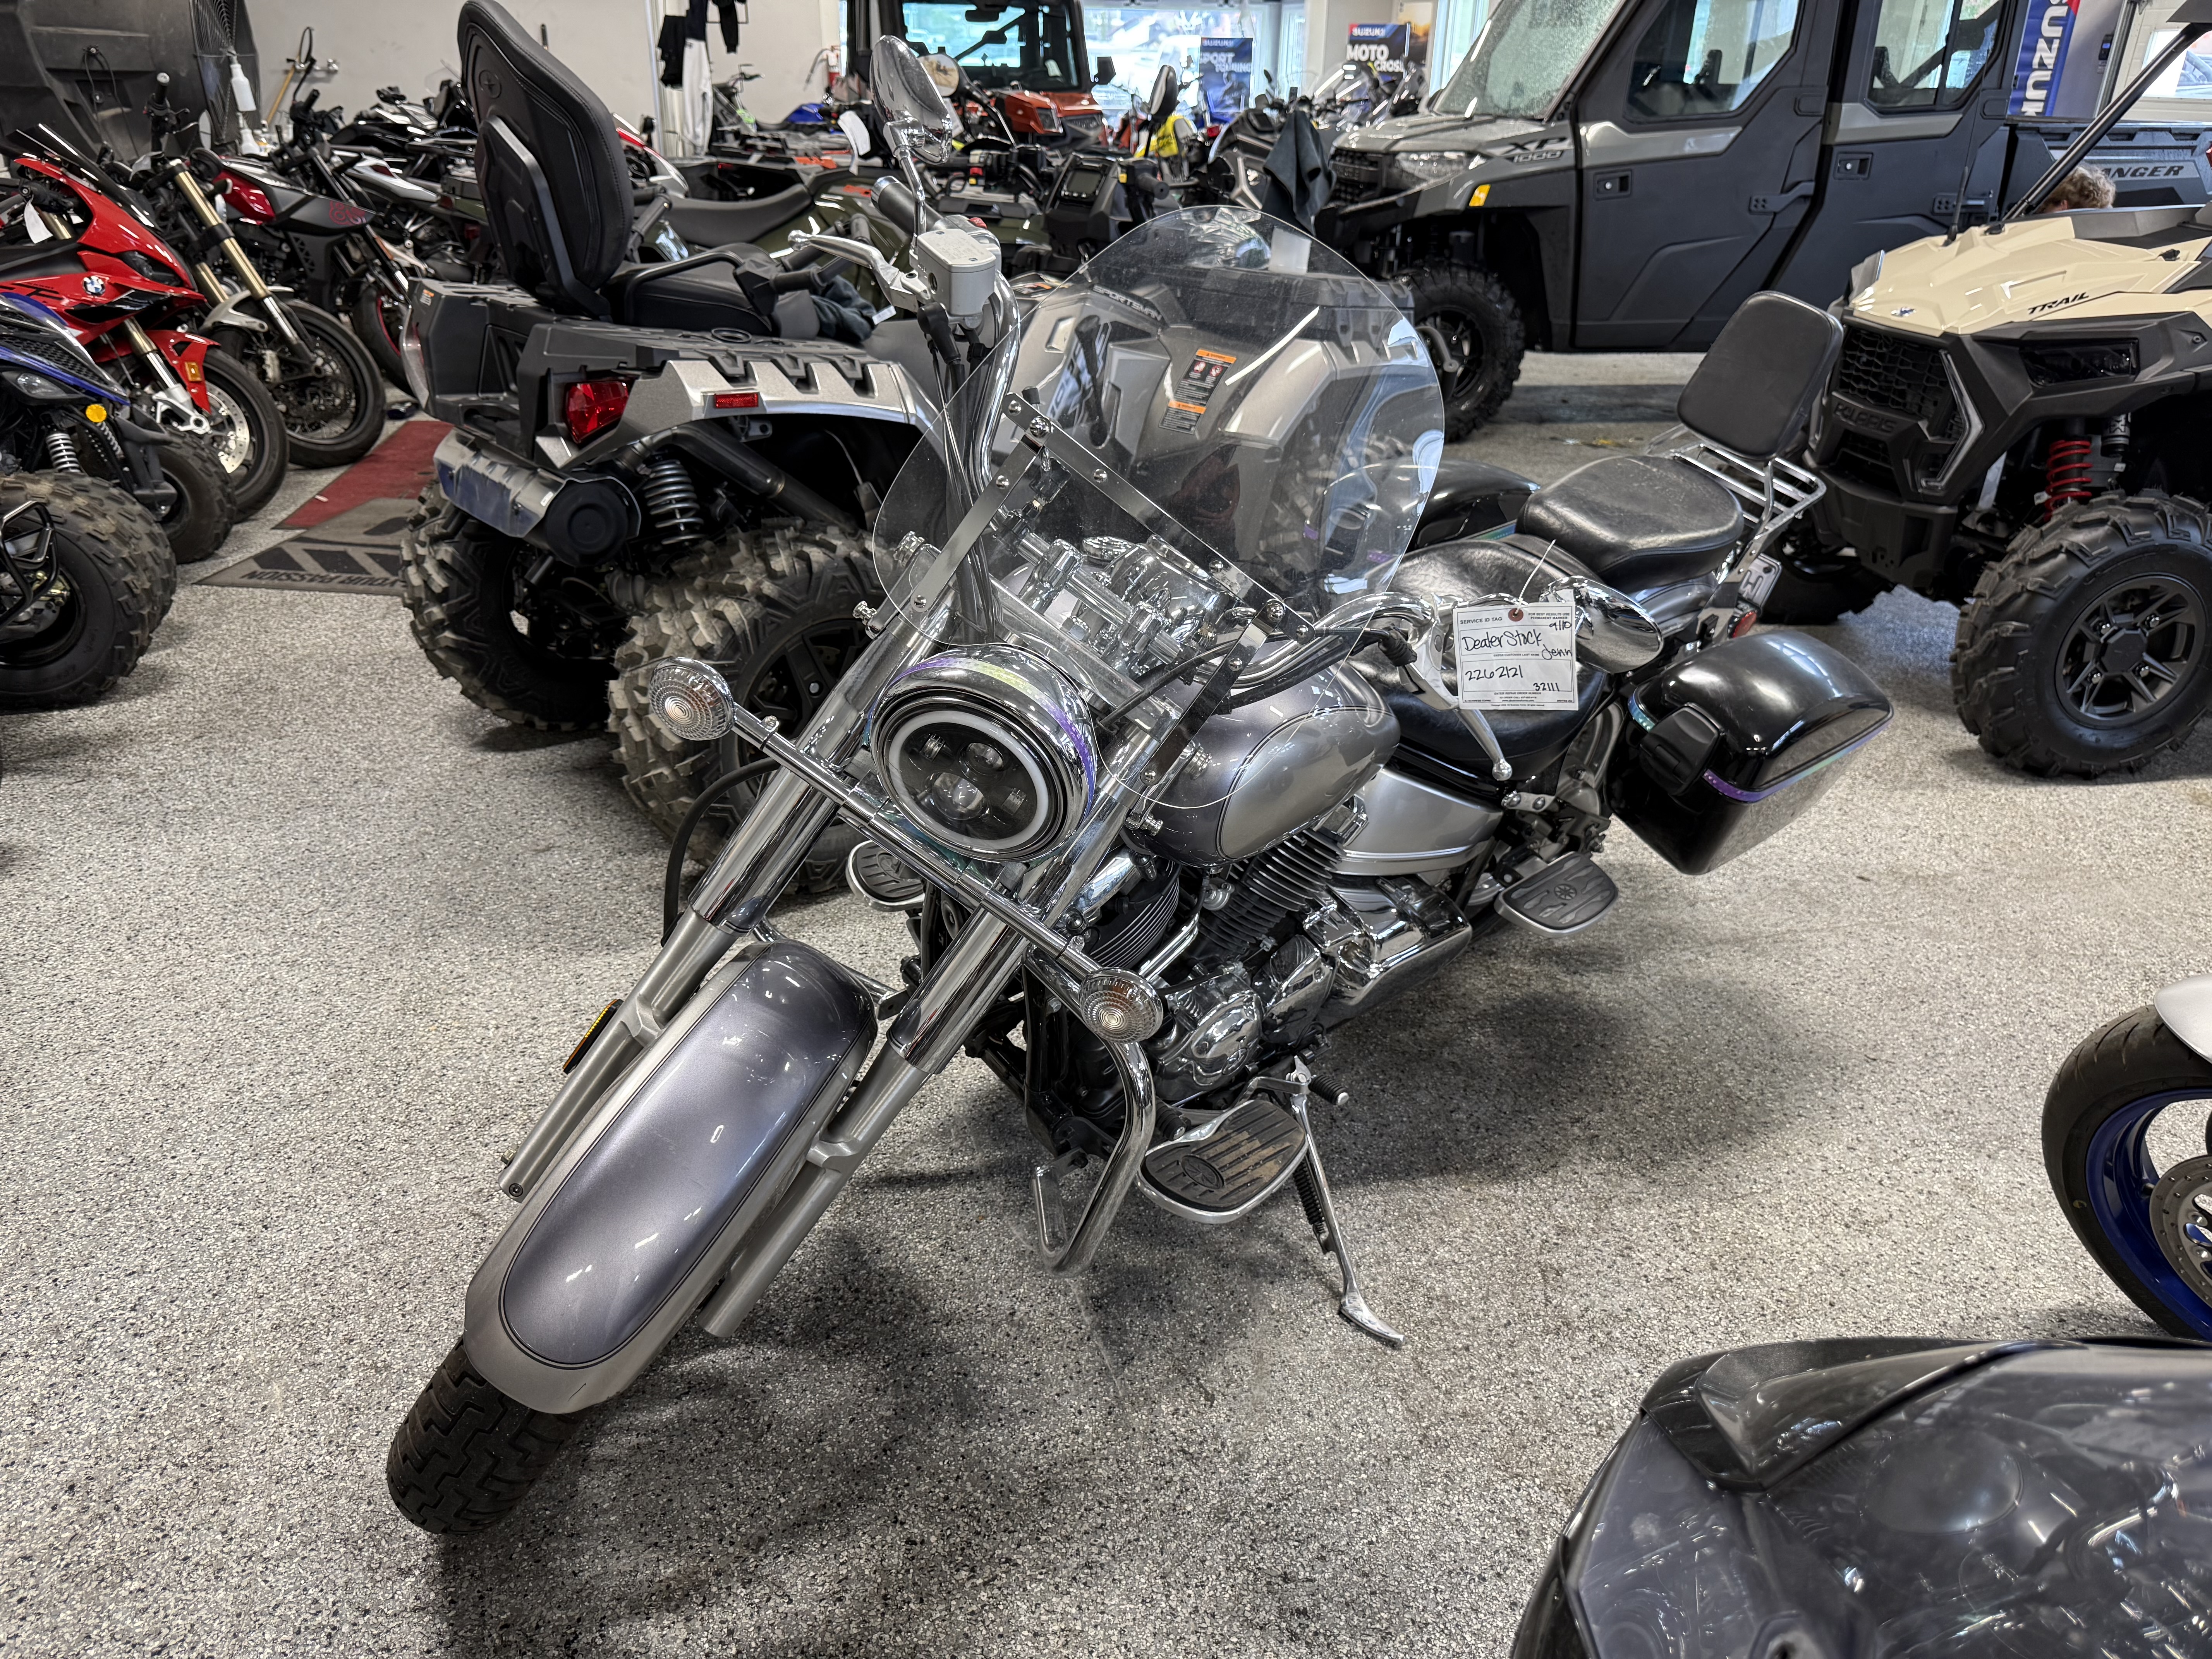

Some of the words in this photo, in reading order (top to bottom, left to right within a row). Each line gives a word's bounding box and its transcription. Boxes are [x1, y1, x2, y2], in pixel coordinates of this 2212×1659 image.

[1352, 27, 1386, 36] SUZUKI
[1346, 43, 1389, 62] MOTO
[1503, 137, 1567, 155] XP
[1513, 150, 1563, 163] 1000
[1093, 284, 1162, 321] SPORTSMAN
[2028, 292, 2089, 314] TRAIL
[1834, 402, 1897, 433] POLARIS
[239, 570, 342, 583] PASSION
[1462, 632, 1503, 651] Dealer
[1465, 665, 1523, 681] 2262121
